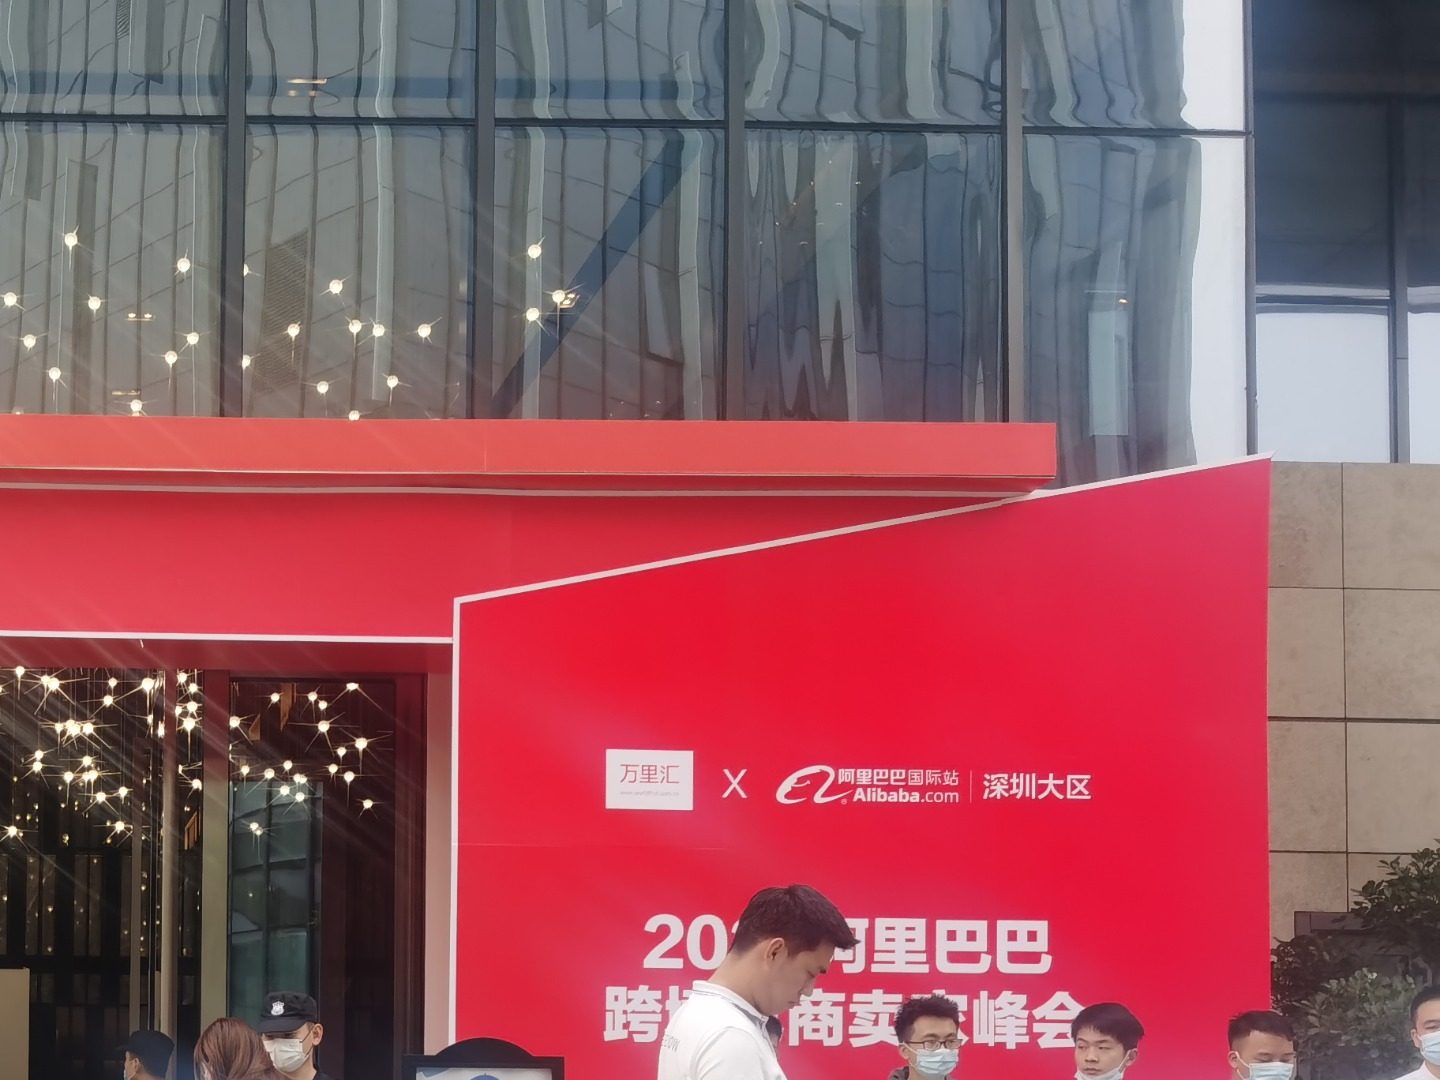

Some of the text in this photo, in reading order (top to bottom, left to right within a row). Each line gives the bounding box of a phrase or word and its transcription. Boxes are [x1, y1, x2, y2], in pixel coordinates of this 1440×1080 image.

[620, 764, 680, 785] 万里汇
[838, 768, 959, 786] 阿里巴巴国际站
[852, 787, 959, 804] Alibaba.com
[982, 773, 1092, 800] 深圳大区
